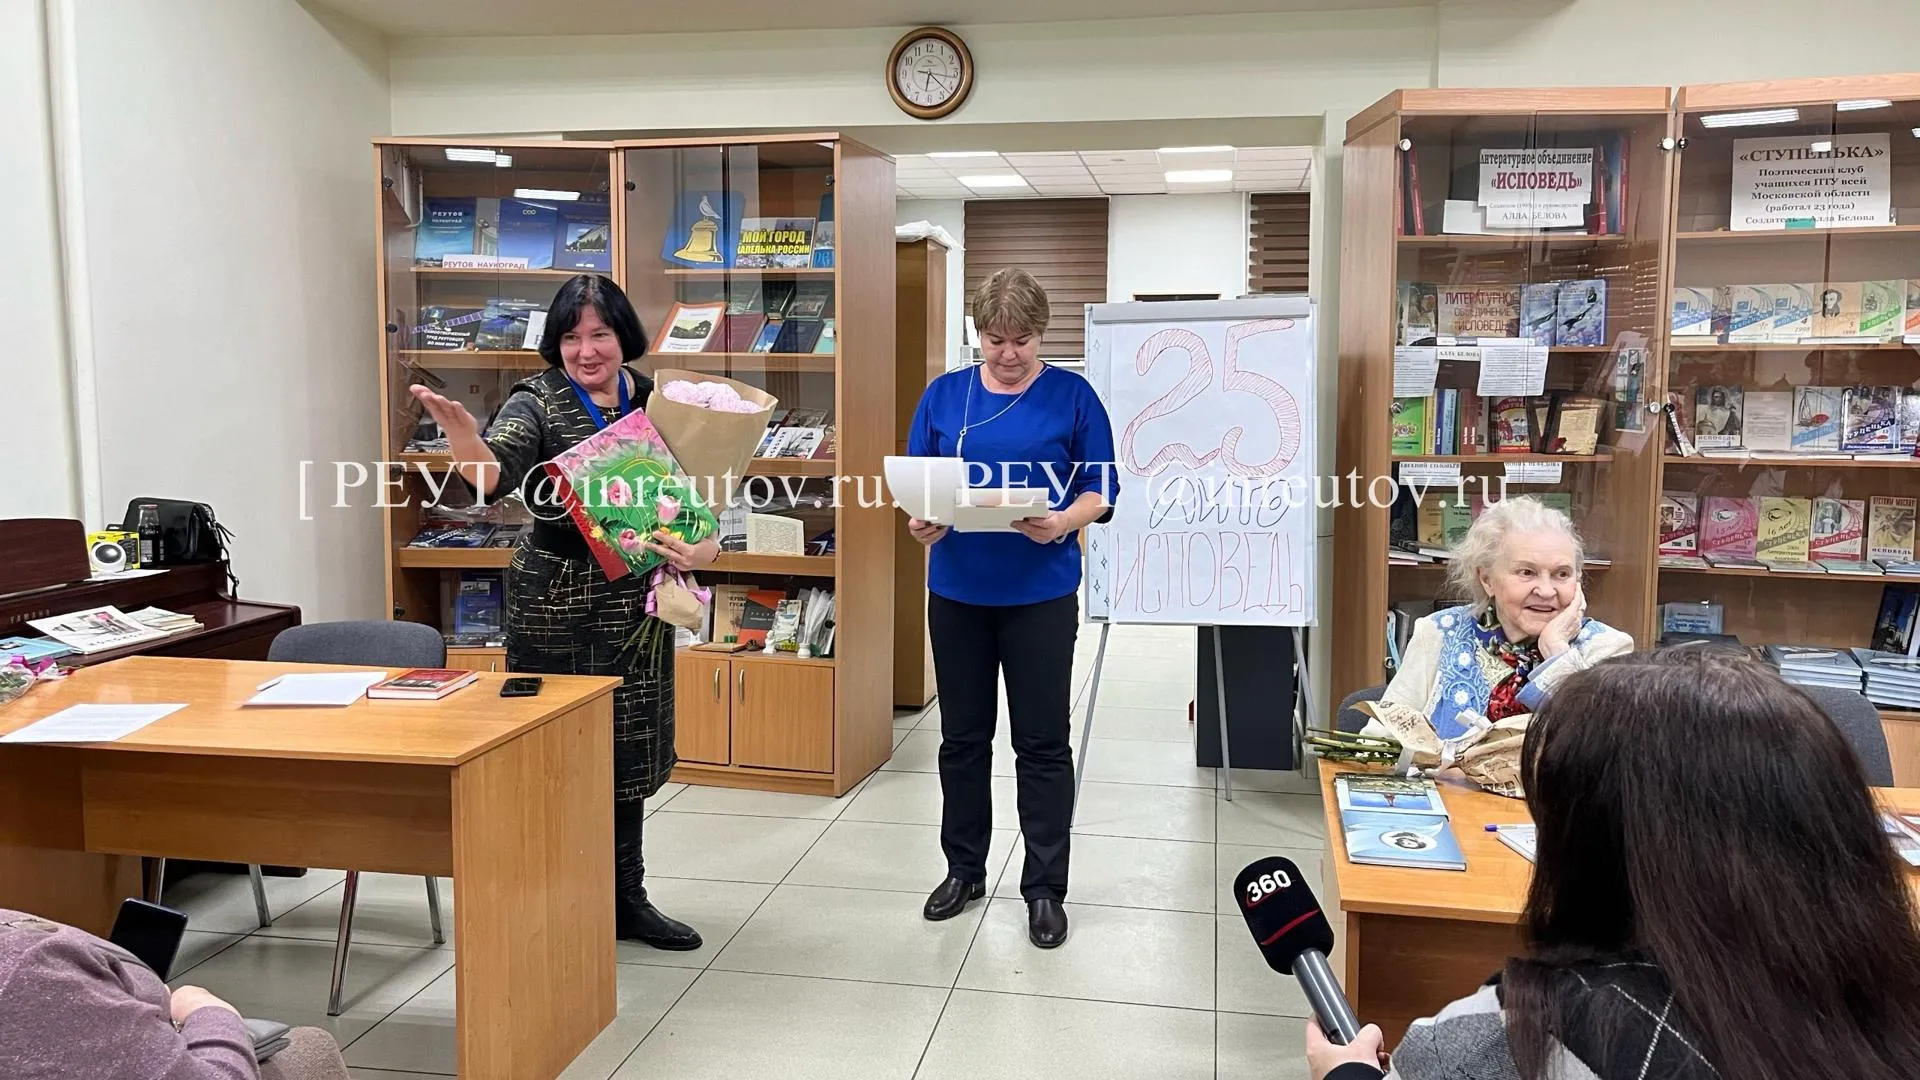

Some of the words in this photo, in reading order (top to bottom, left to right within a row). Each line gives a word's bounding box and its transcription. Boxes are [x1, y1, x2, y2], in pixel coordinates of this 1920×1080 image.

[914, 46, 921, 57] 11
[926, 43, 935, 53] 12
[940, 45, 944, 56] 1
[905, 56, 913, 66] 10
[949, 54, 954, 65] 2
[1537, 150, 1592, 166] объединение
[1759, 166, 1834, 177] Поэтический
[1837, 165, 1864, 177] клуб
[1491, 172, 1583, 192] «ИСПОВЕДЬ»
[1754, 179, 1811, 189] учащихся
[1813, 178, 1839, 187] ПТУ
[1841, 177, 1867, 186] всей
[1751, 189, 1821, 200] Московской
[1823, 187, 1870, 198] области
[1765, 203, 1811, 213] (работал
[1813, 204, 1826, 213] 23
[1828, 202, 1855, 213] года)
[1502, 211, 1528, 220] АЛЛА
[1838, 213, 1875, 223] Белова
[743, 226, 767, 243] МОЙ
[769, 231, 806, 244] ГОРОД
[777, 244, 810, 256] РОССИИ
[1445, 291, 1520, 306] ЛИТЕРАТУРНОЕ
[1121, 318, 1301, 478] 25
[1686, 539, 1694, 547] 15
[1114, 531, 1302, 615] ИСПОВЕДЬ
[1247, 870, 1292, 902] 360
